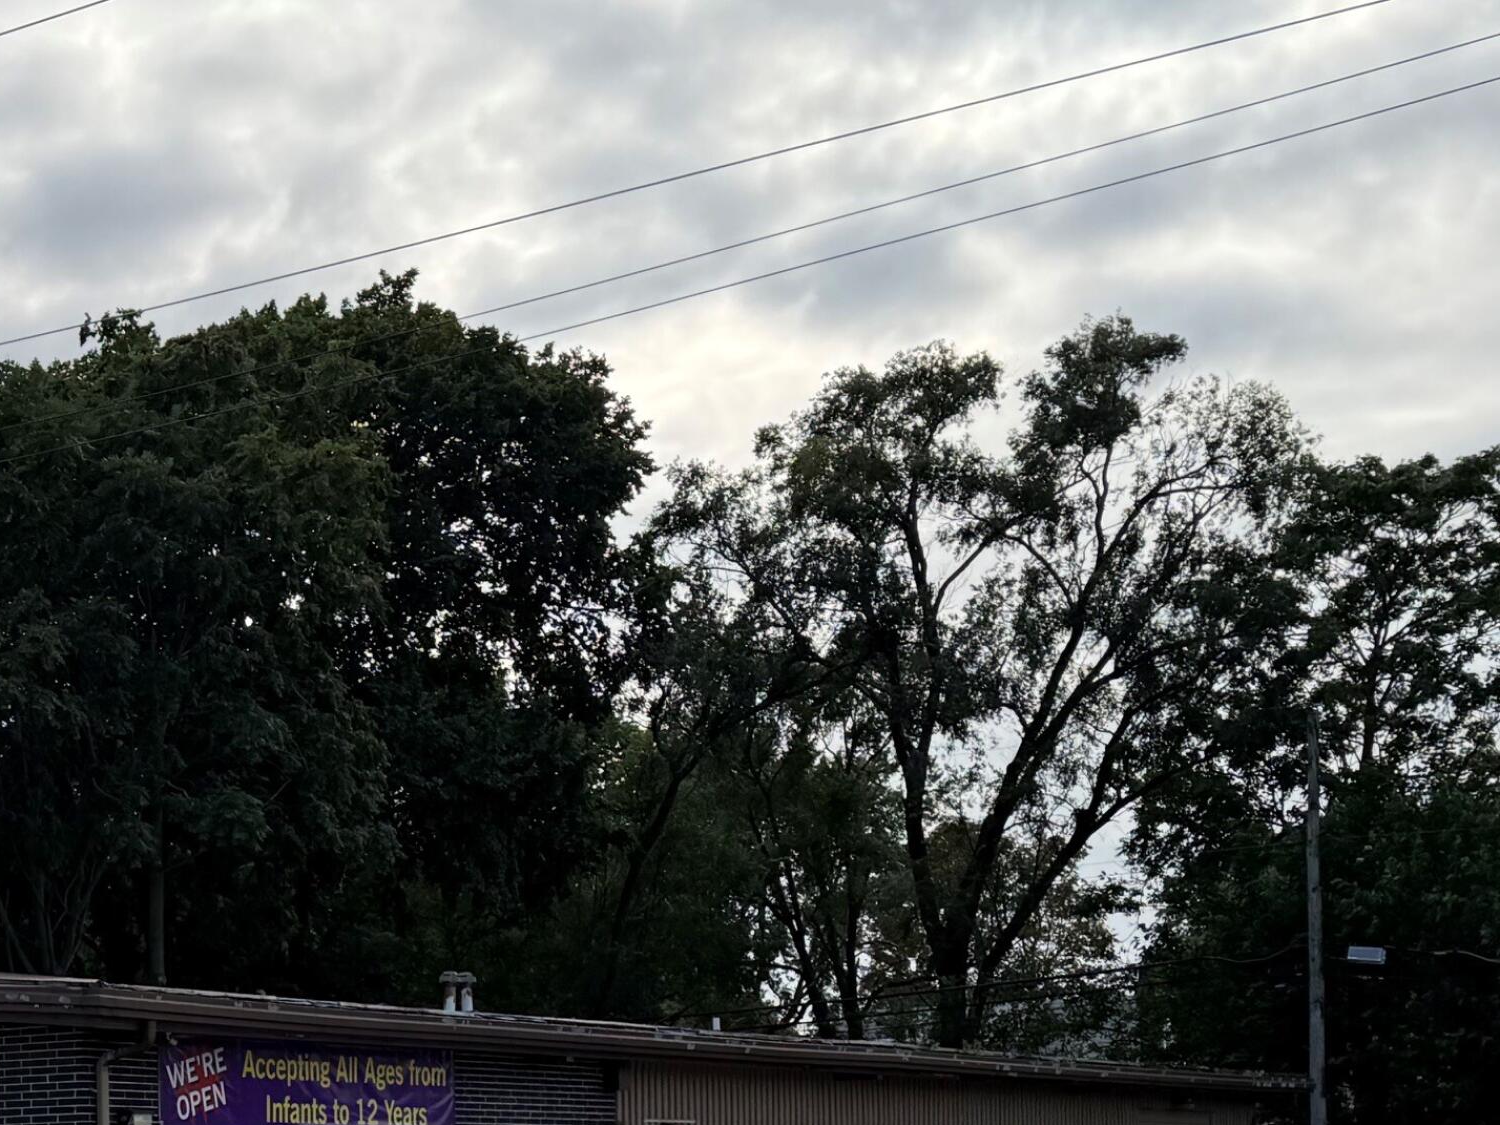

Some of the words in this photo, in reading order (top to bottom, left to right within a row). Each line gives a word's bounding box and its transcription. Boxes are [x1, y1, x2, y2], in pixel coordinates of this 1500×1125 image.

[165, 1046, 228, 1089] WE'RE
[241, 1049, 332, 1089] Accepting
[335, 1054, 358, 1084] All
[363, 1056, 405, 1091] Ages
[409, 1058, 447, 1088] from
[175, 1081, 228, 1121] OPEN
[265, 1093, 328, 1125] Infants
[332, 1097, 351, 1125] to
